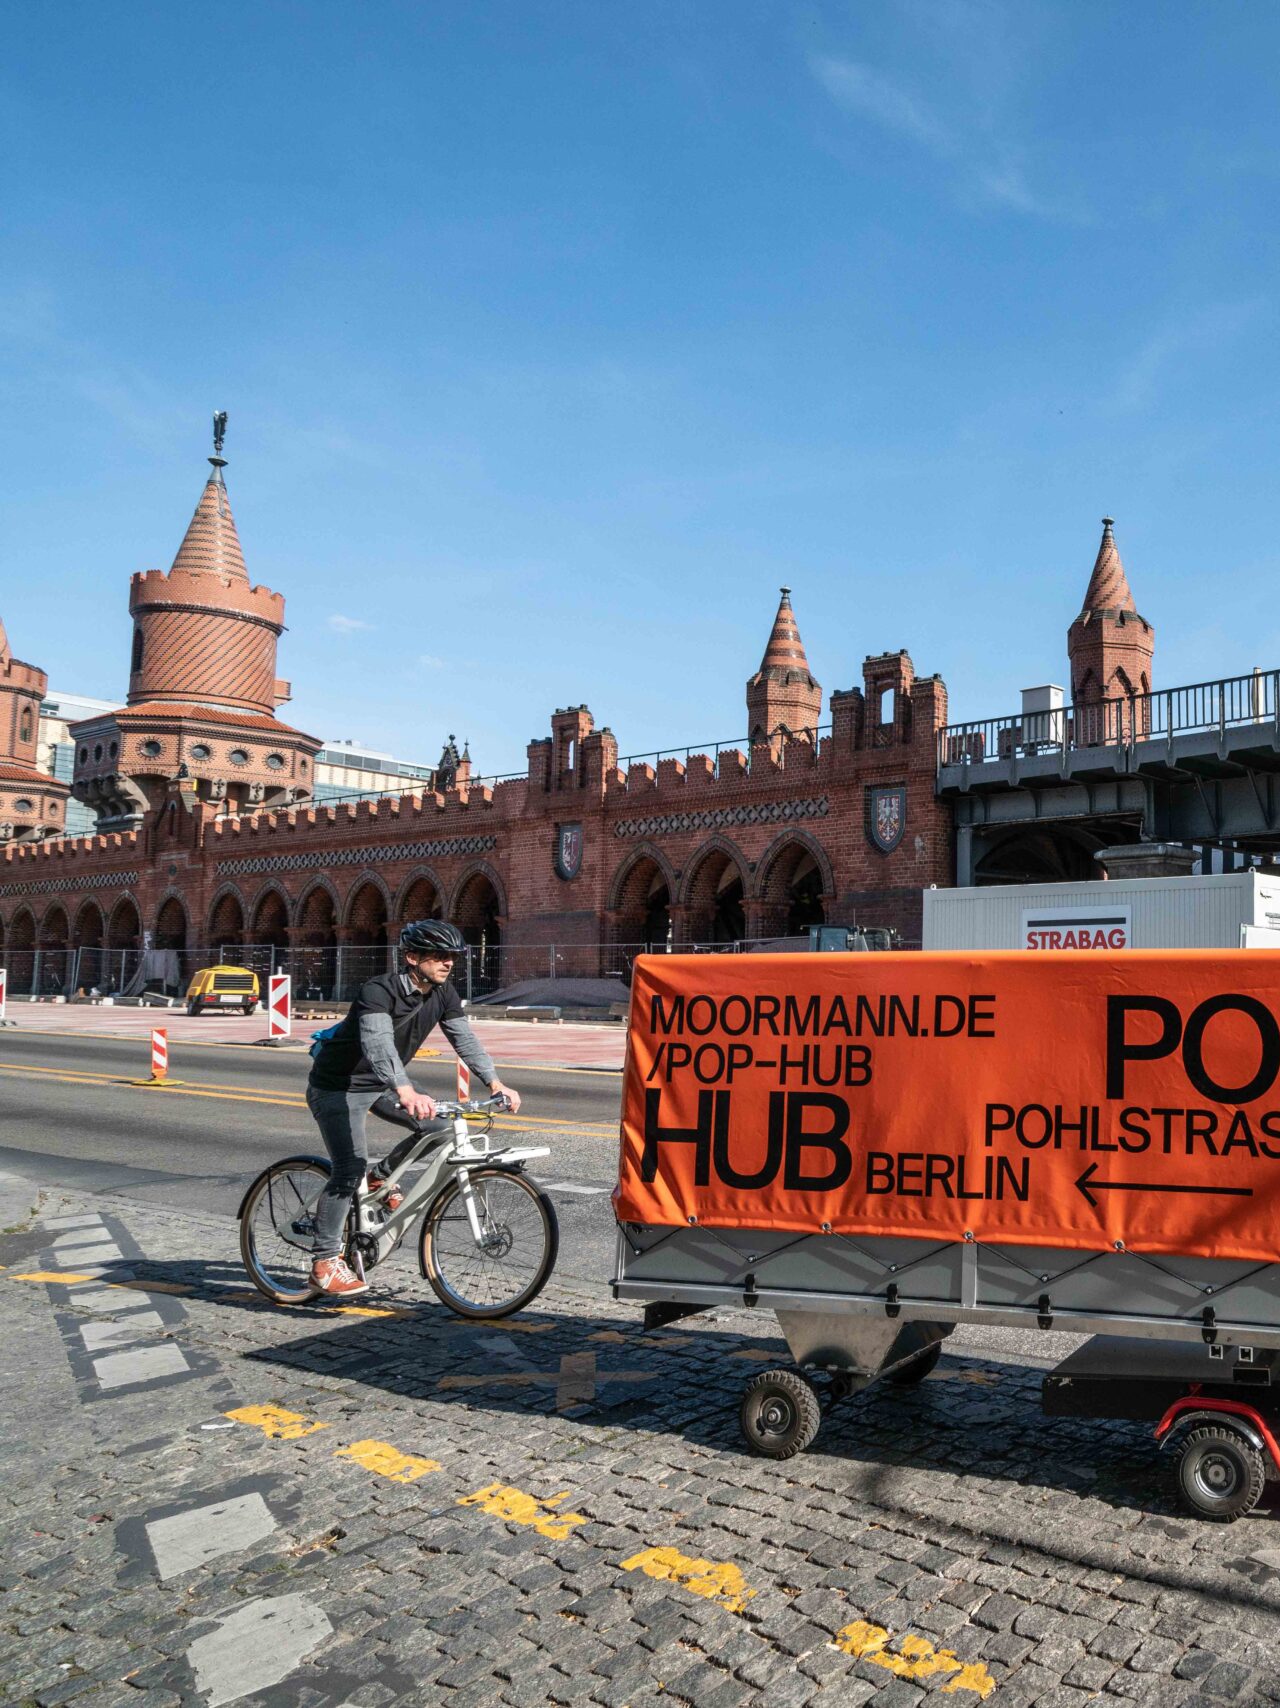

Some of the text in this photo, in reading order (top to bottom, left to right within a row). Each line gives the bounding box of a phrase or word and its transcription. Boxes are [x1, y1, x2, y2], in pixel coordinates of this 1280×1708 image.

[1026, 928, 1127, 950] STRABAG
[650, 994, 997, 1039] MOORMANN.DE
[647, 1043, 874, 1088] /POP-HUB
[640, 1088, 854, 1194] HUB
[866, 1151, 1031, 1203] BERLIN
